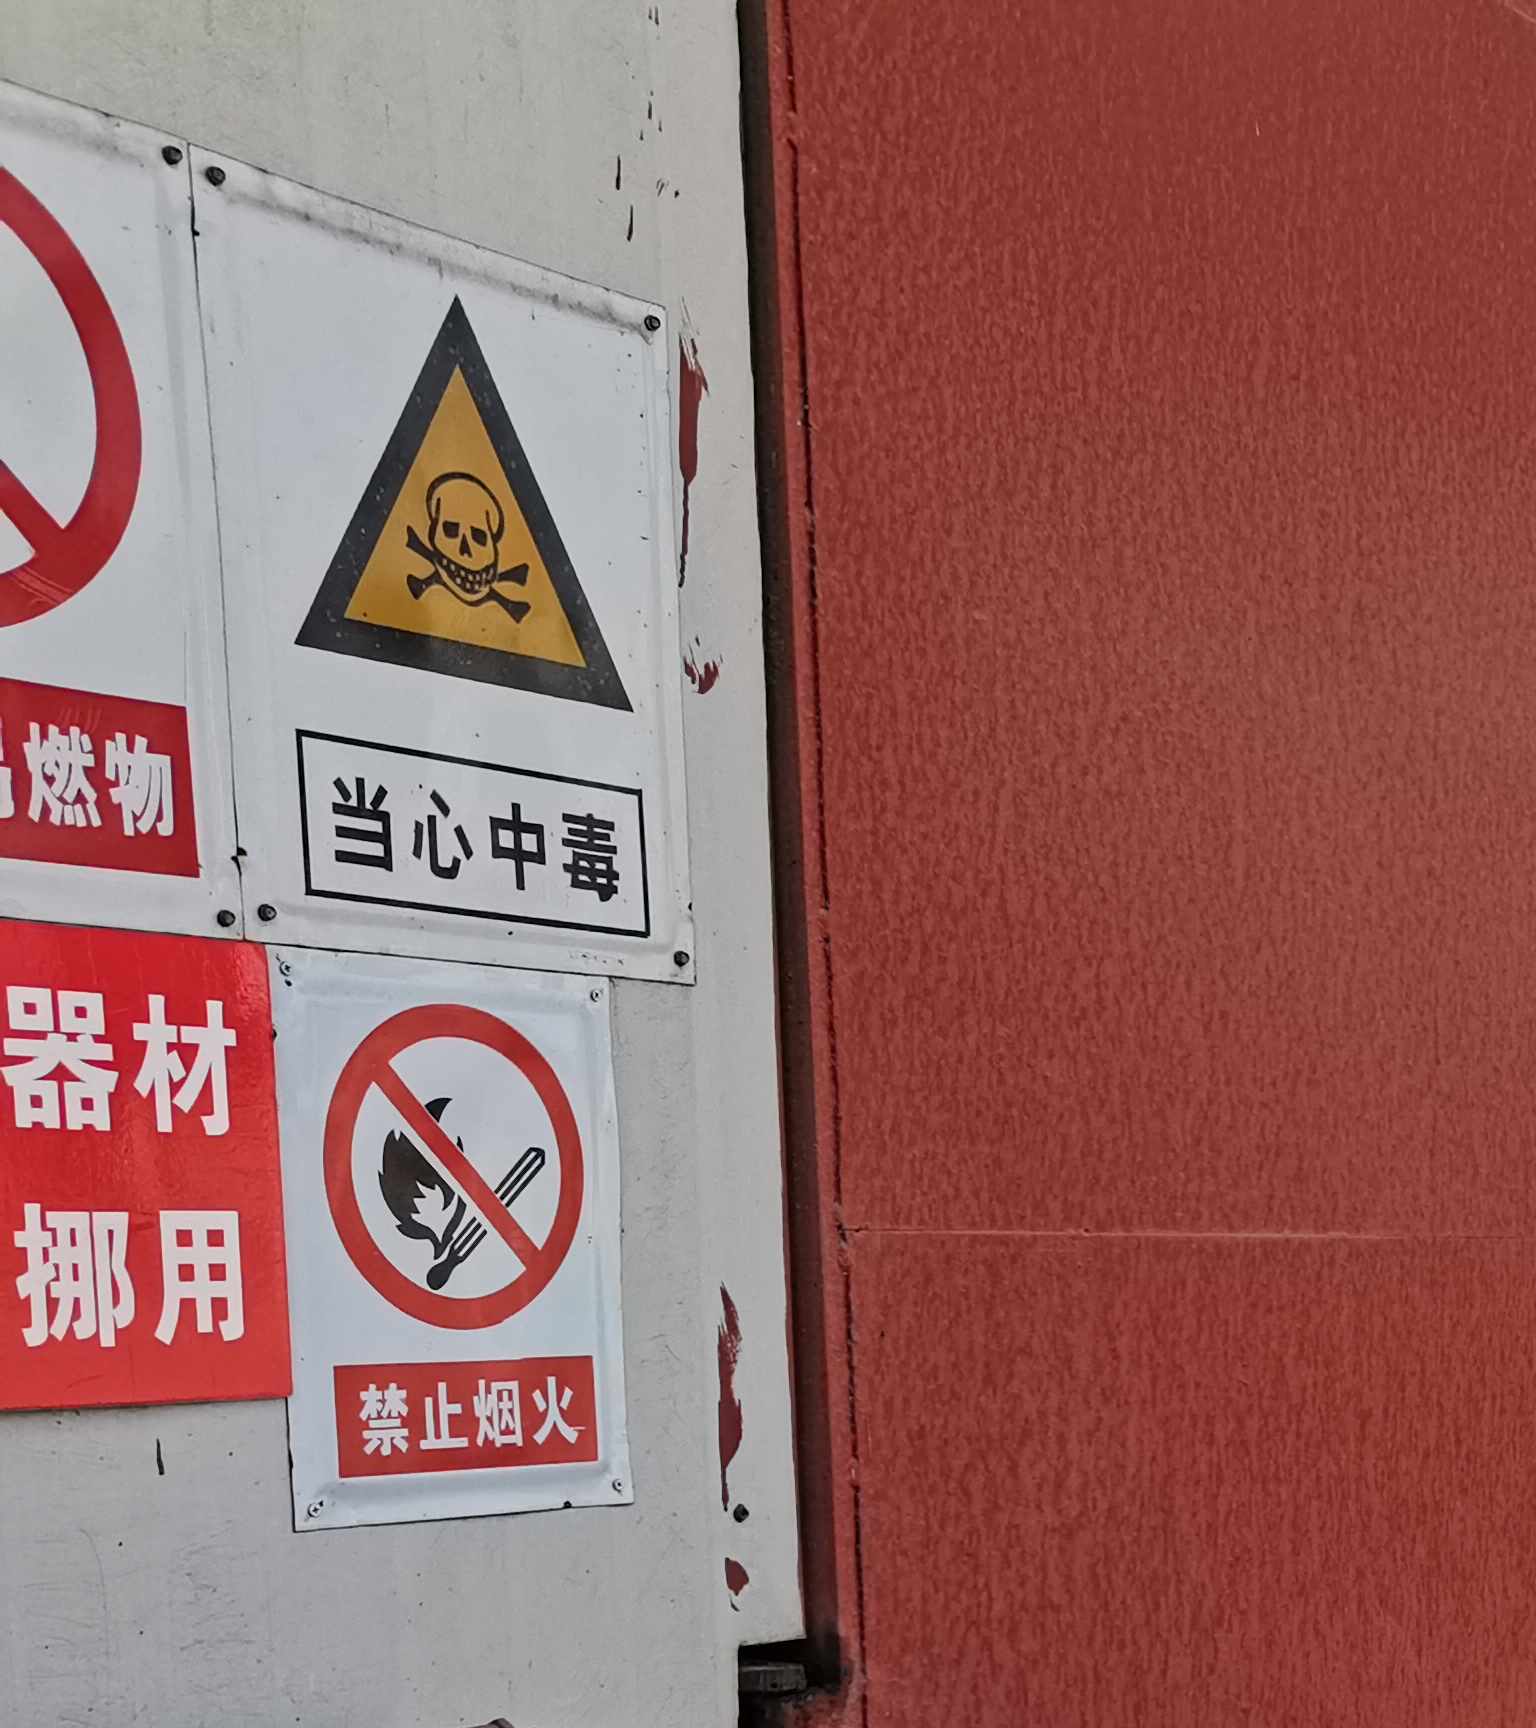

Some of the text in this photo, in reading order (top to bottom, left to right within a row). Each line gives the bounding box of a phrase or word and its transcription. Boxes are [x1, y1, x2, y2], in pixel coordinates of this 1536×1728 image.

[0, 716, 174, 837] 燃物
[333, 777, 619, 902] 当心中毒
[0, 985, 237, 1136] 器材
[14, 1203, 245, 1347] 挪用
[359, 1376, 580, 1457] 禁止烟火
